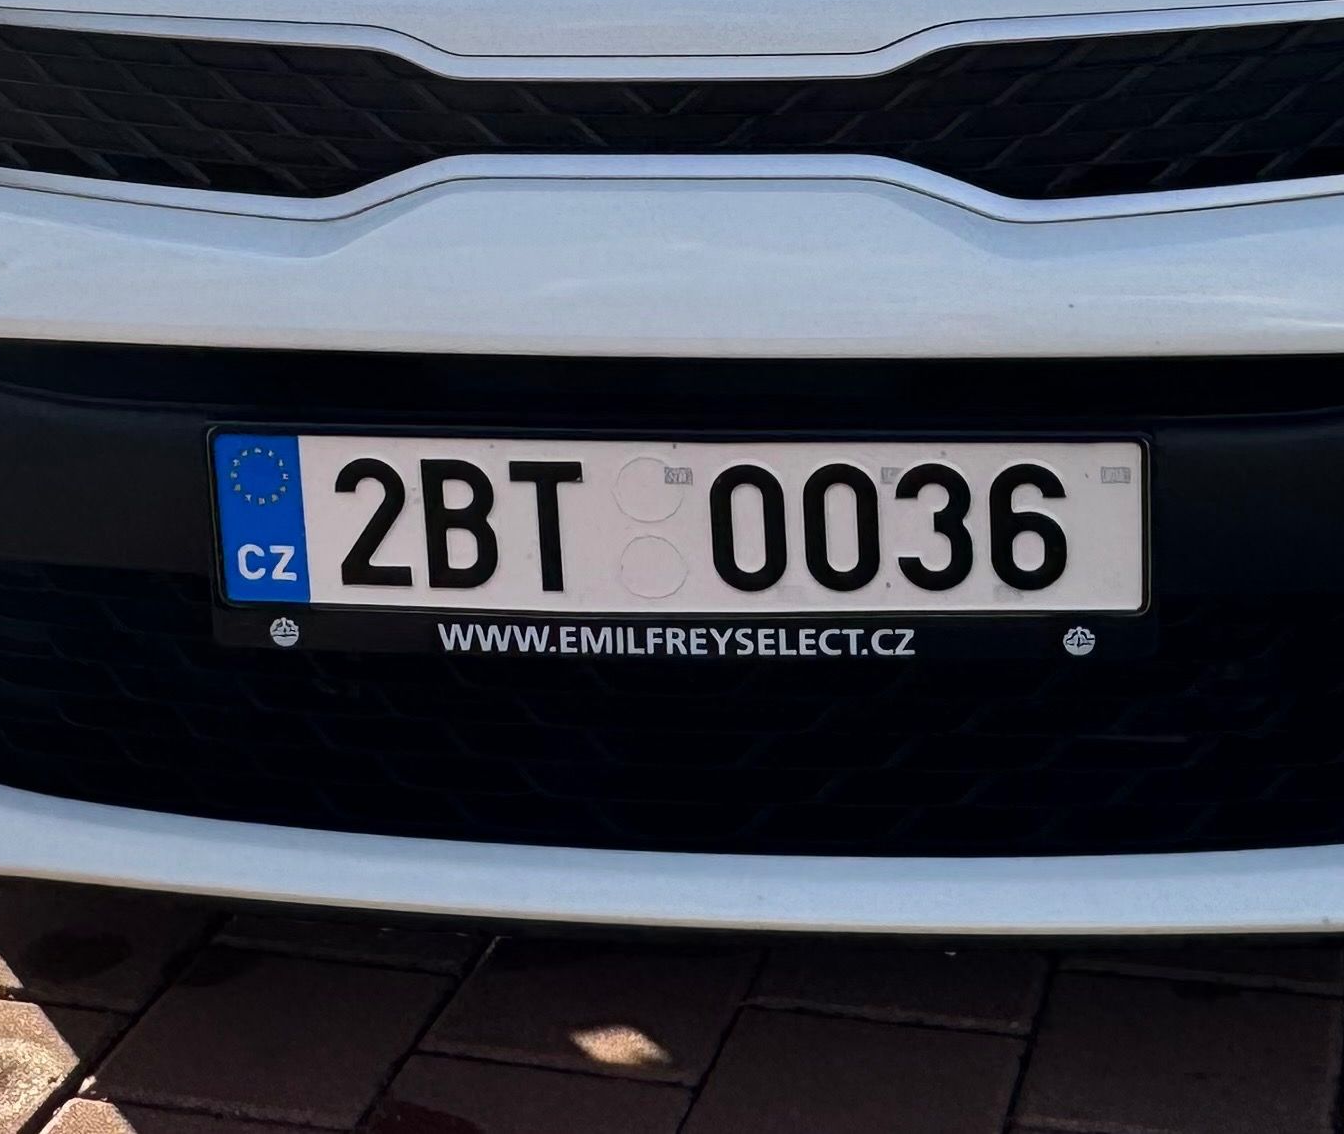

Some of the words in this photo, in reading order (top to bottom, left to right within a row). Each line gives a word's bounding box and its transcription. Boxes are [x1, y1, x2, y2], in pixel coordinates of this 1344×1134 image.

[333, 457, 583, 593] 2BT
[708, 462, 1068, 593] 0036
[236, 544, 298, 581] CZ
[436, 622, 916, 656] WWW.EMILFREYSELECT.CZ
